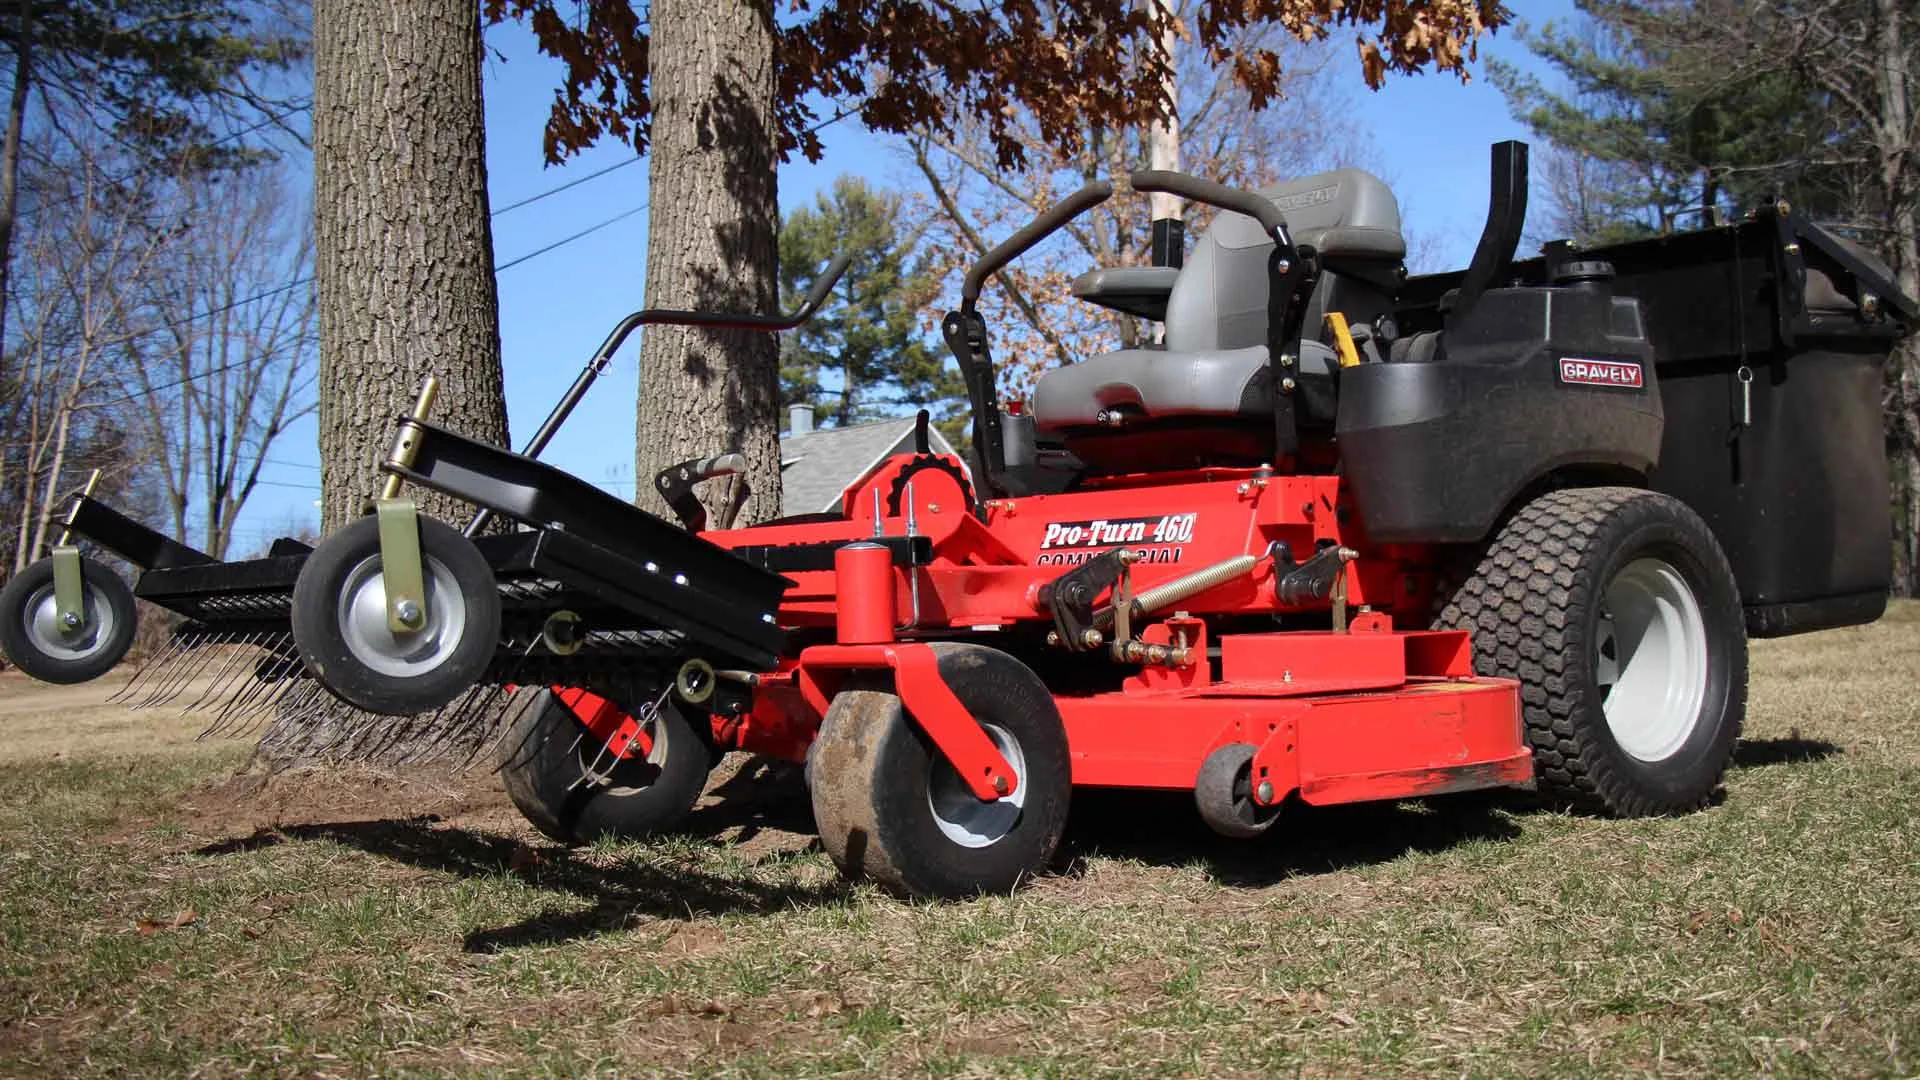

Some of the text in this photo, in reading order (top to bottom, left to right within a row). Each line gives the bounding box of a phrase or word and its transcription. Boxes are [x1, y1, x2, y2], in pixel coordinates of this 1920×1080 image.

[1563, 363, 1638, 382] GRAVELY
[1040, 515, 1194, 549] Pro-Turn 460
